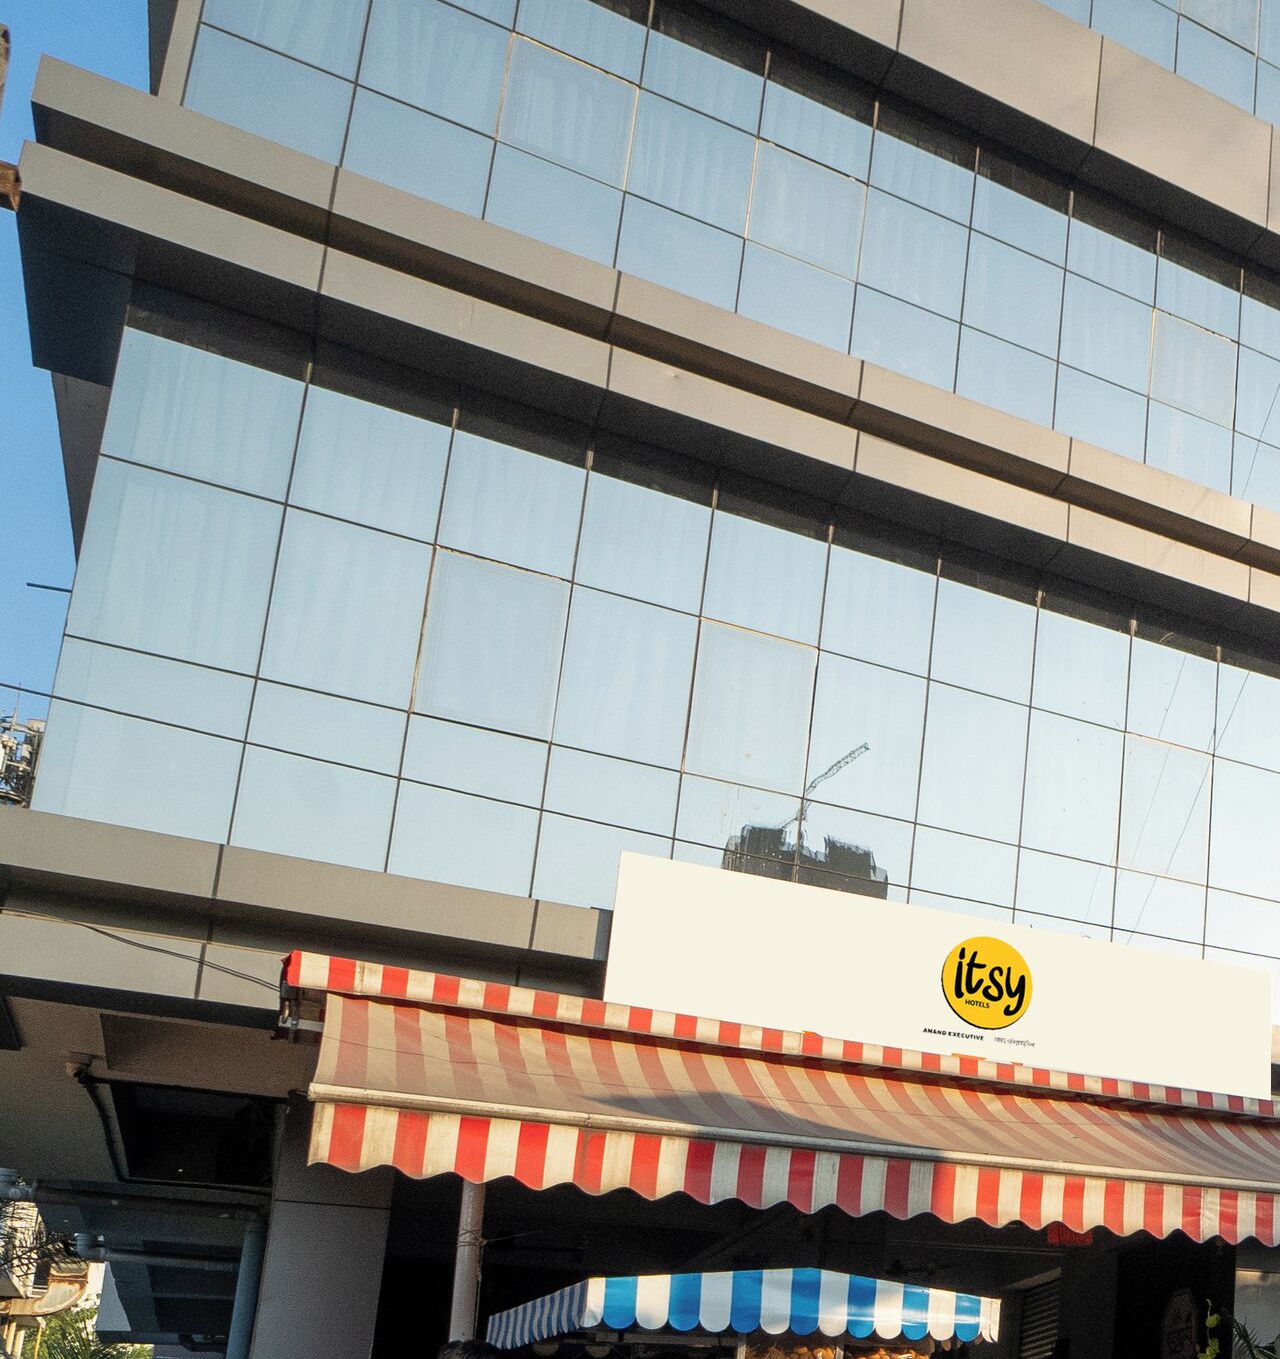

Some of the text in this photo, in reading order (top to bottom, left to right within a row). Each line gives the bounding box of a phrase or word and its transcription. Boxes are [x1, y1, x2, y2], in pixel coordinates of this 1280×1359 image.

[954, 947, 1026, 1016] itsy
[965, 999, 990, 1009] HOTELS
[922, 1027, 984, 1041] ANAND EXECUTIVE
